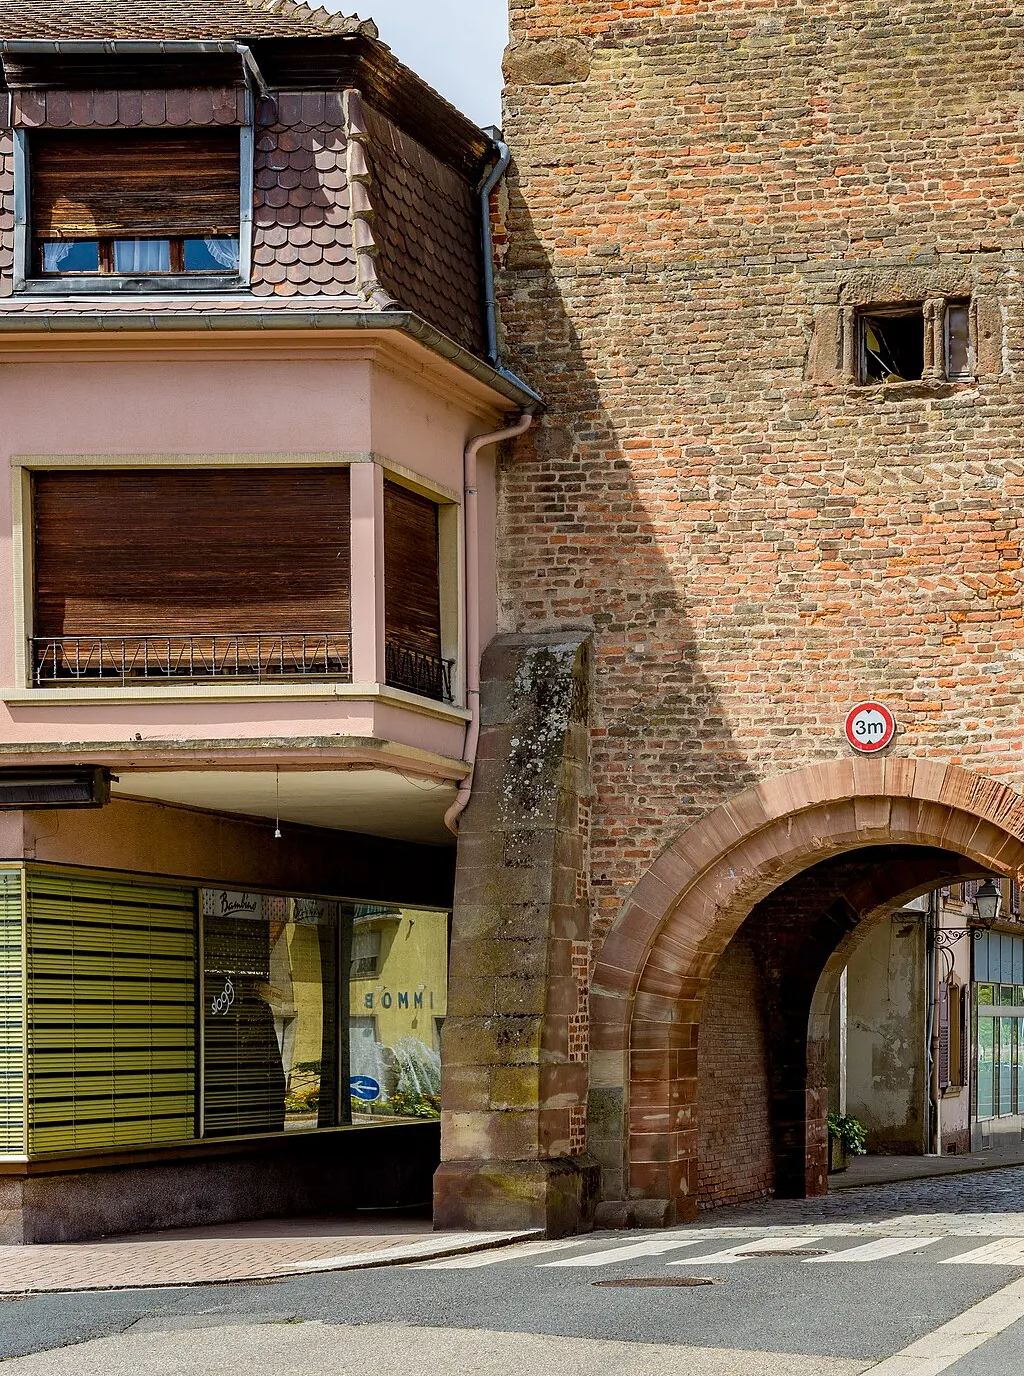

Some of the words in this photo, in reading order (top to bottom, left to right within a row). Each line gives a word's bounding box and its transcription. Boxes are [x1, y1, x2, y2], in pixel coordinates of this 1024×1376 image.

[855, 720, 883, 735] 3m
[219, 891, 257, 914] Bambino
[211, 976, 234, 1016] sloggi
